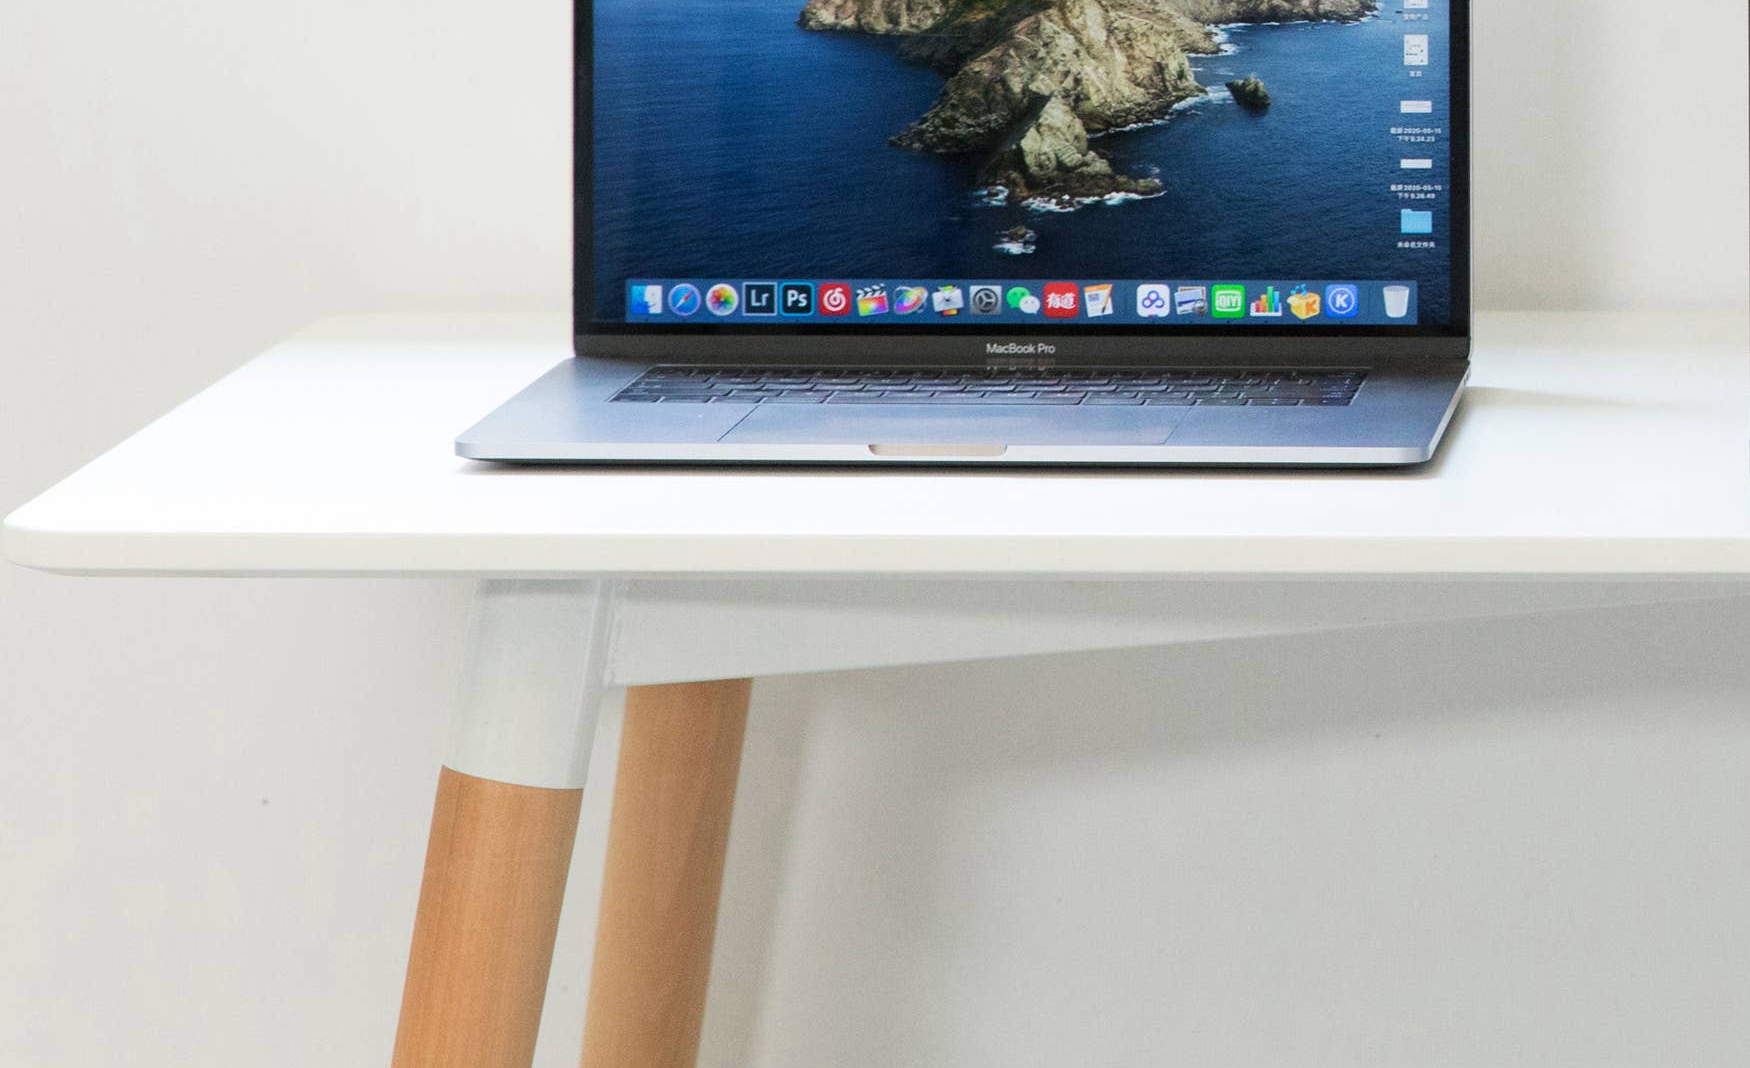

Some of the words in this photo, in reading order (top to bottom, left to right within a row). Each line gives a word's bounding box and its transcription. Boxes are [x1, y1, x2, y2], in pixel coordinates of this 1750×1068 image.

[751, 289, 769, 307] Lr
[786, 289, 808, 308] Ps
[1046, 293, 1078, 310] 有道
[1336, 293, 1349, 308] K
[985, 343, 1036, 354] MacBook
[1037, 343, 1056, 354] Pro
